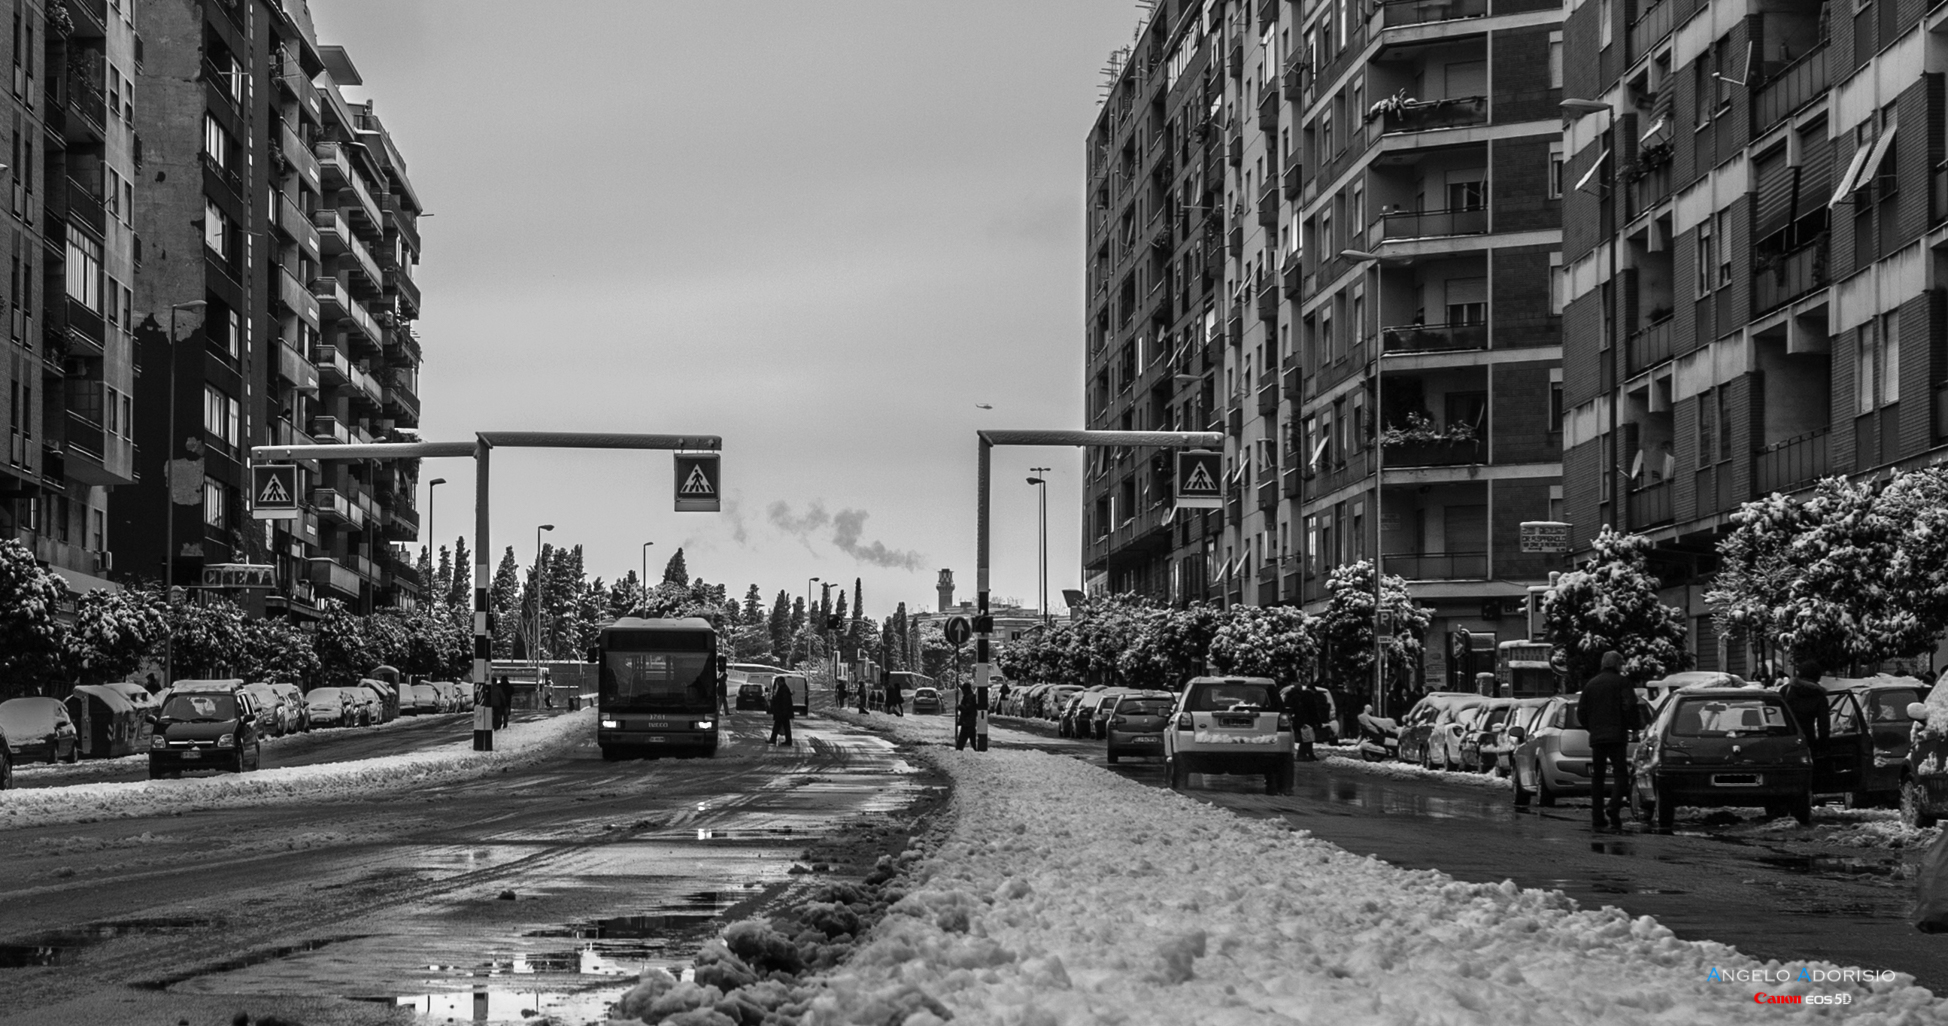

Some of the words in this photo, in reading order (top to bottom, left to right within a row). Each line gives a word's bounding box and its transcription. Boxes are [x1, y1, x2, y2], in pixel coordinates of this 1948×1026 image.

[204, 568, 274, 586] CINEMA
[1380, 612, 1389, 624] P
[1762, 706, 1778, 723] P
